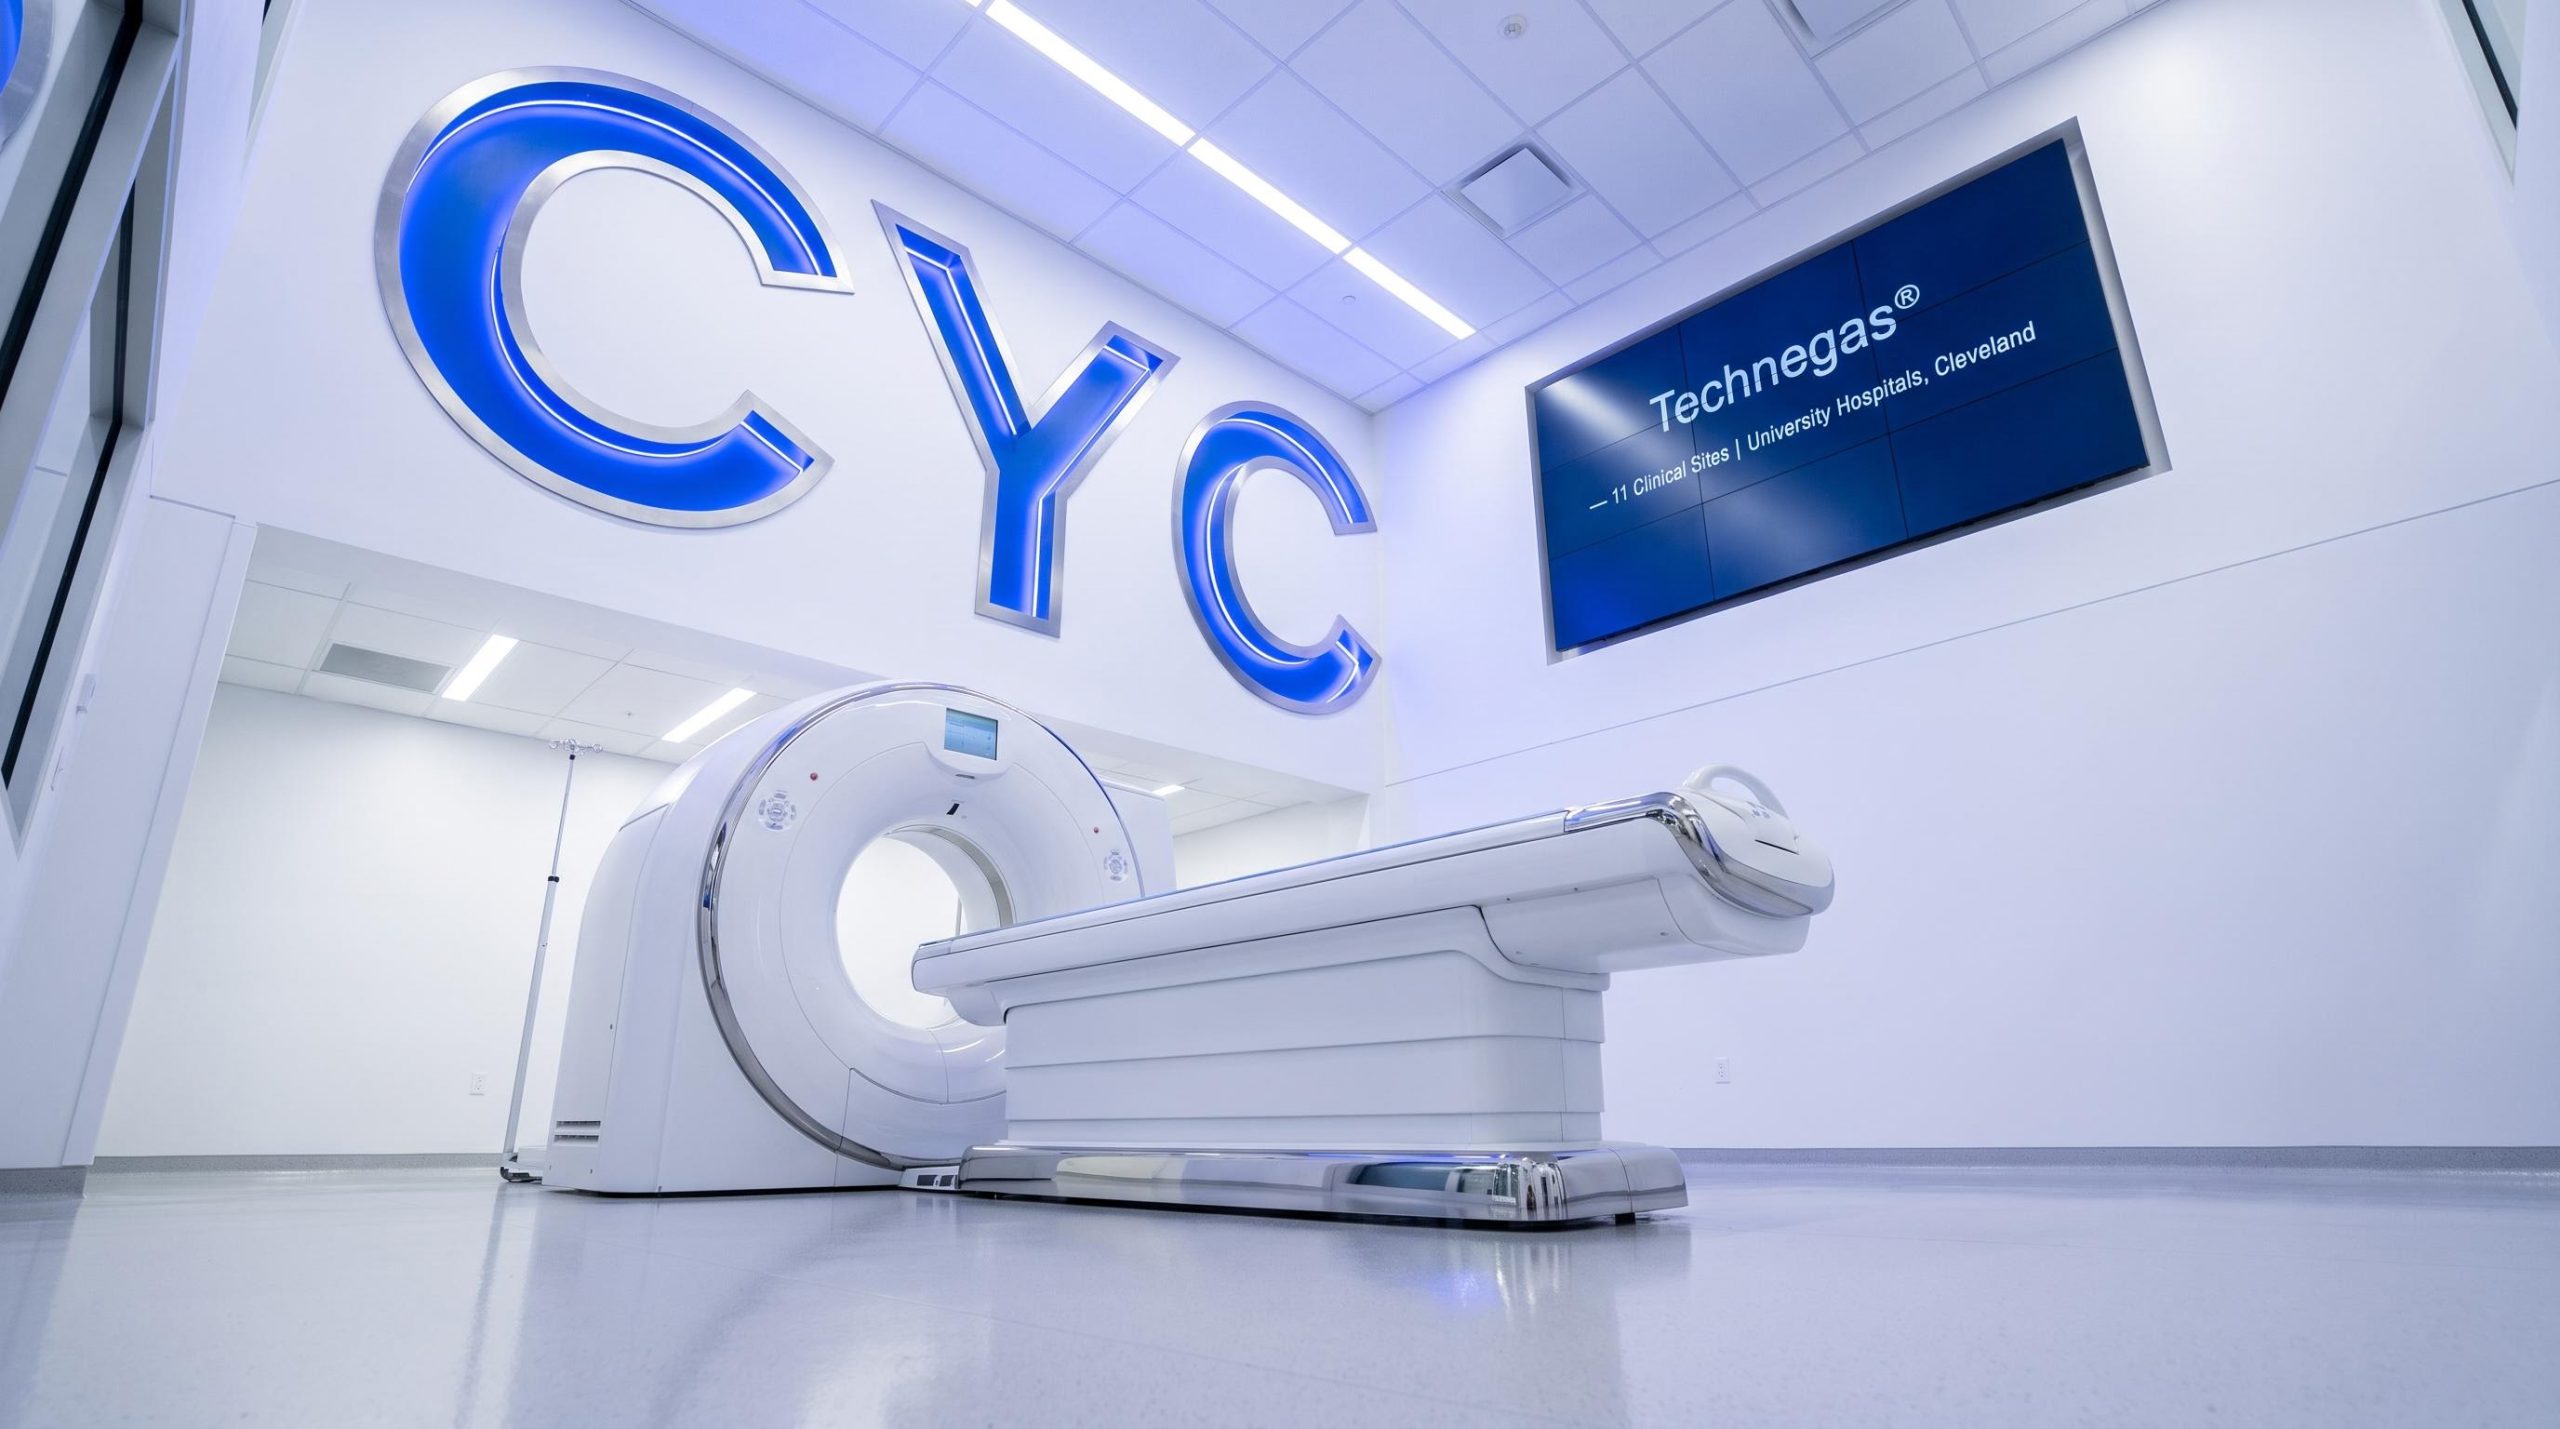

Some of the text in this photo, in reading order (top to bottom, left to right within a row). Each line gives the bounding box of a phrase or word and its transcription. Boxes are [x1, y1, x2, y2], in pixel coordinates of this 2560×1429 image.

[374, 65, 1382, 716] CYC
[1611, 484, 1627, 504] 11
[1633, 460, 1687, 496] Clinical
[1691, 447, 1730, 474] Sites
[1747, 406, 1831, 451] University
[1836, 368, 1929, 416] Hospitals,
[1934, 320, 2036, 377] Cleveland
[1648, 284, 1921, 433] Technegas®
